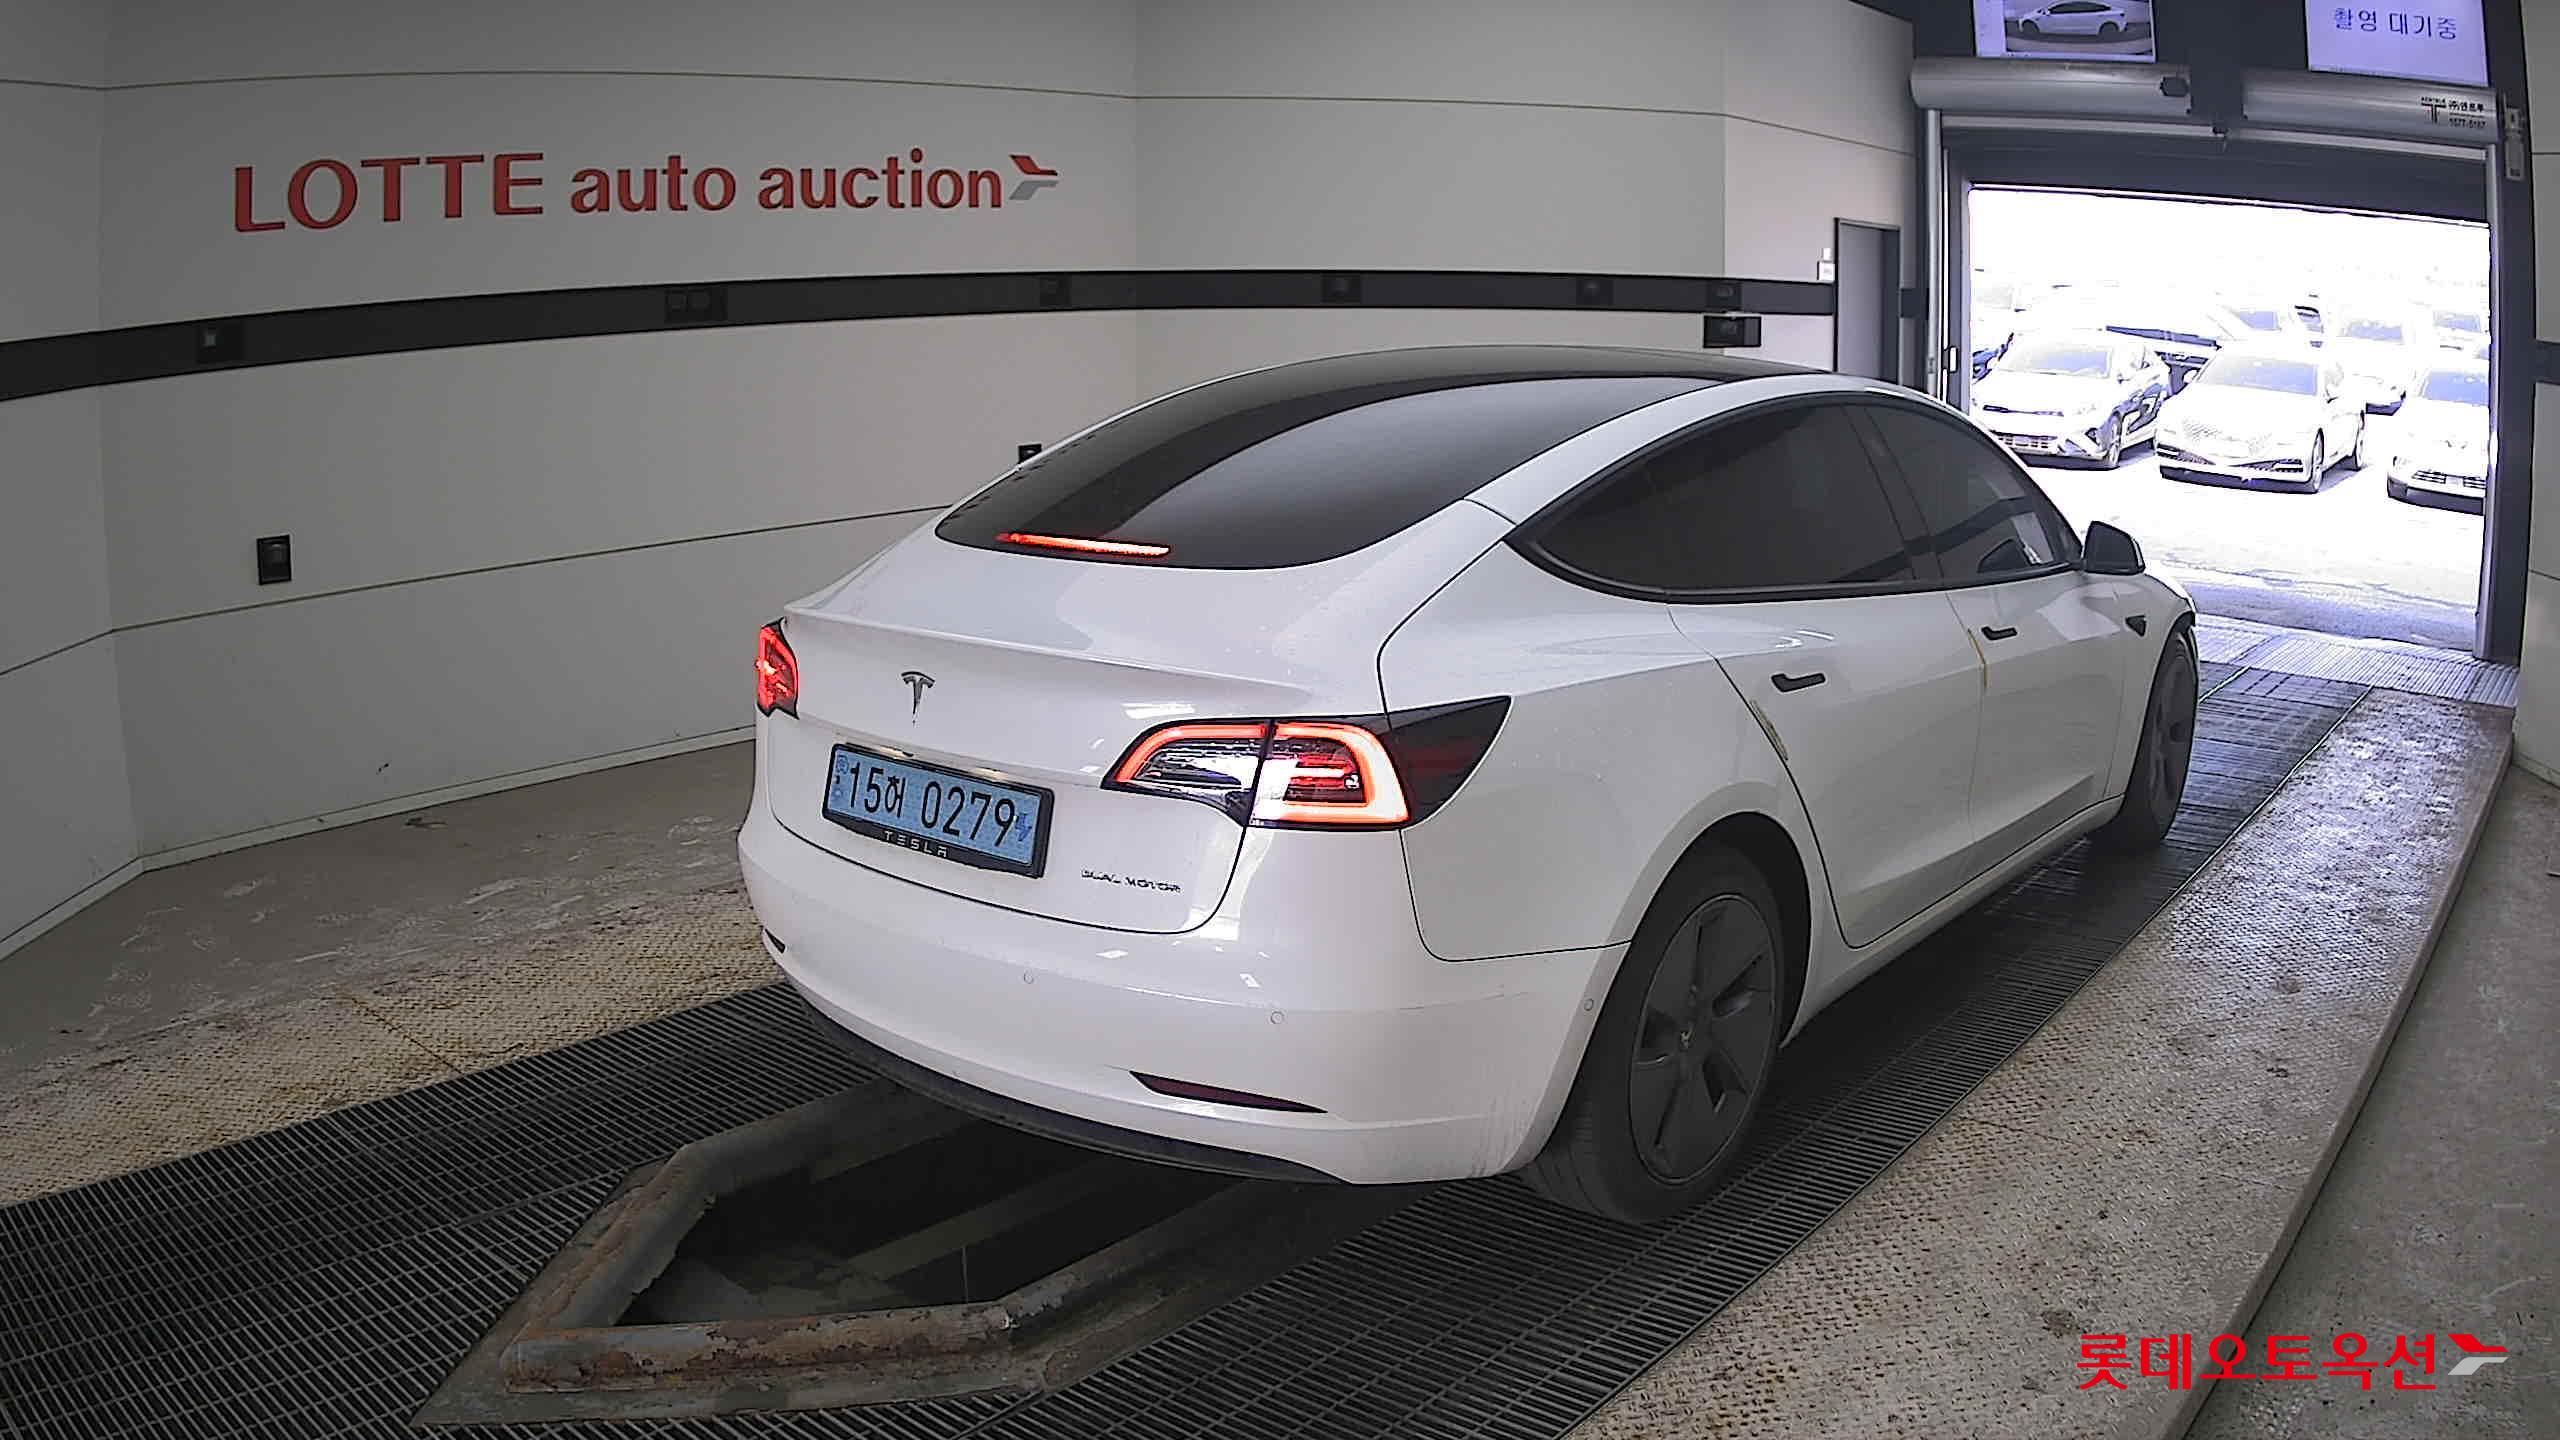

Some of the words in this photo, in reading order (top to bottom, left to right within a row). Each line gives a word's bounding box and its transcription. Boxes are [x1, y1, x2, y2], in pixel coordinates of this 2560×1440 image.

[2389, 12, 2457, 40] 대기중
[235, 152, 544, 232] LOTTE
[570, 155, 737, 213] auto
[758, 147, 1002, 210] auction
[850, 761, 906, 818] 15허
[920, 780, 1016, 847] 0279
[883, 830, 949, 859] TESLA
[1125, 876, 1181, 893] MOTOR
